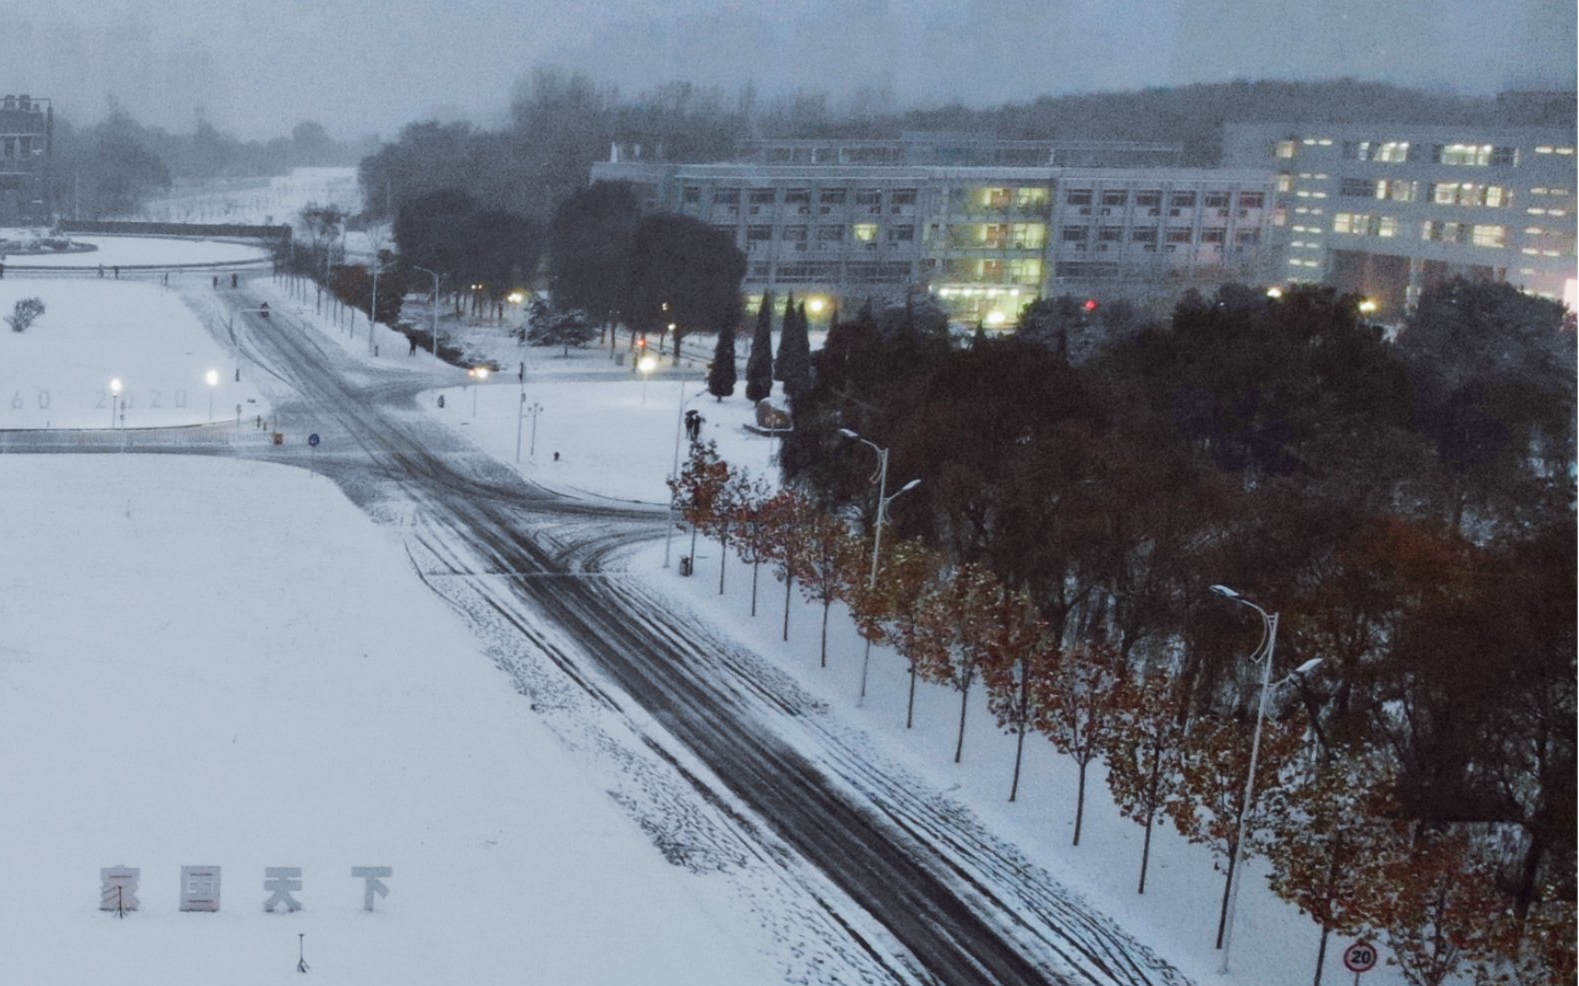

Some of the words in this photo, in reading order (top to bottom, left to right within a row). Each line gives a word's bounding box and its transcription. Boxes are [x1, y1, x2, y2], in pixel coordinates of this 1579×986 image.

[98, 865, 393, 913] 家国天下
[1351, 950, 1371, 964] 20
